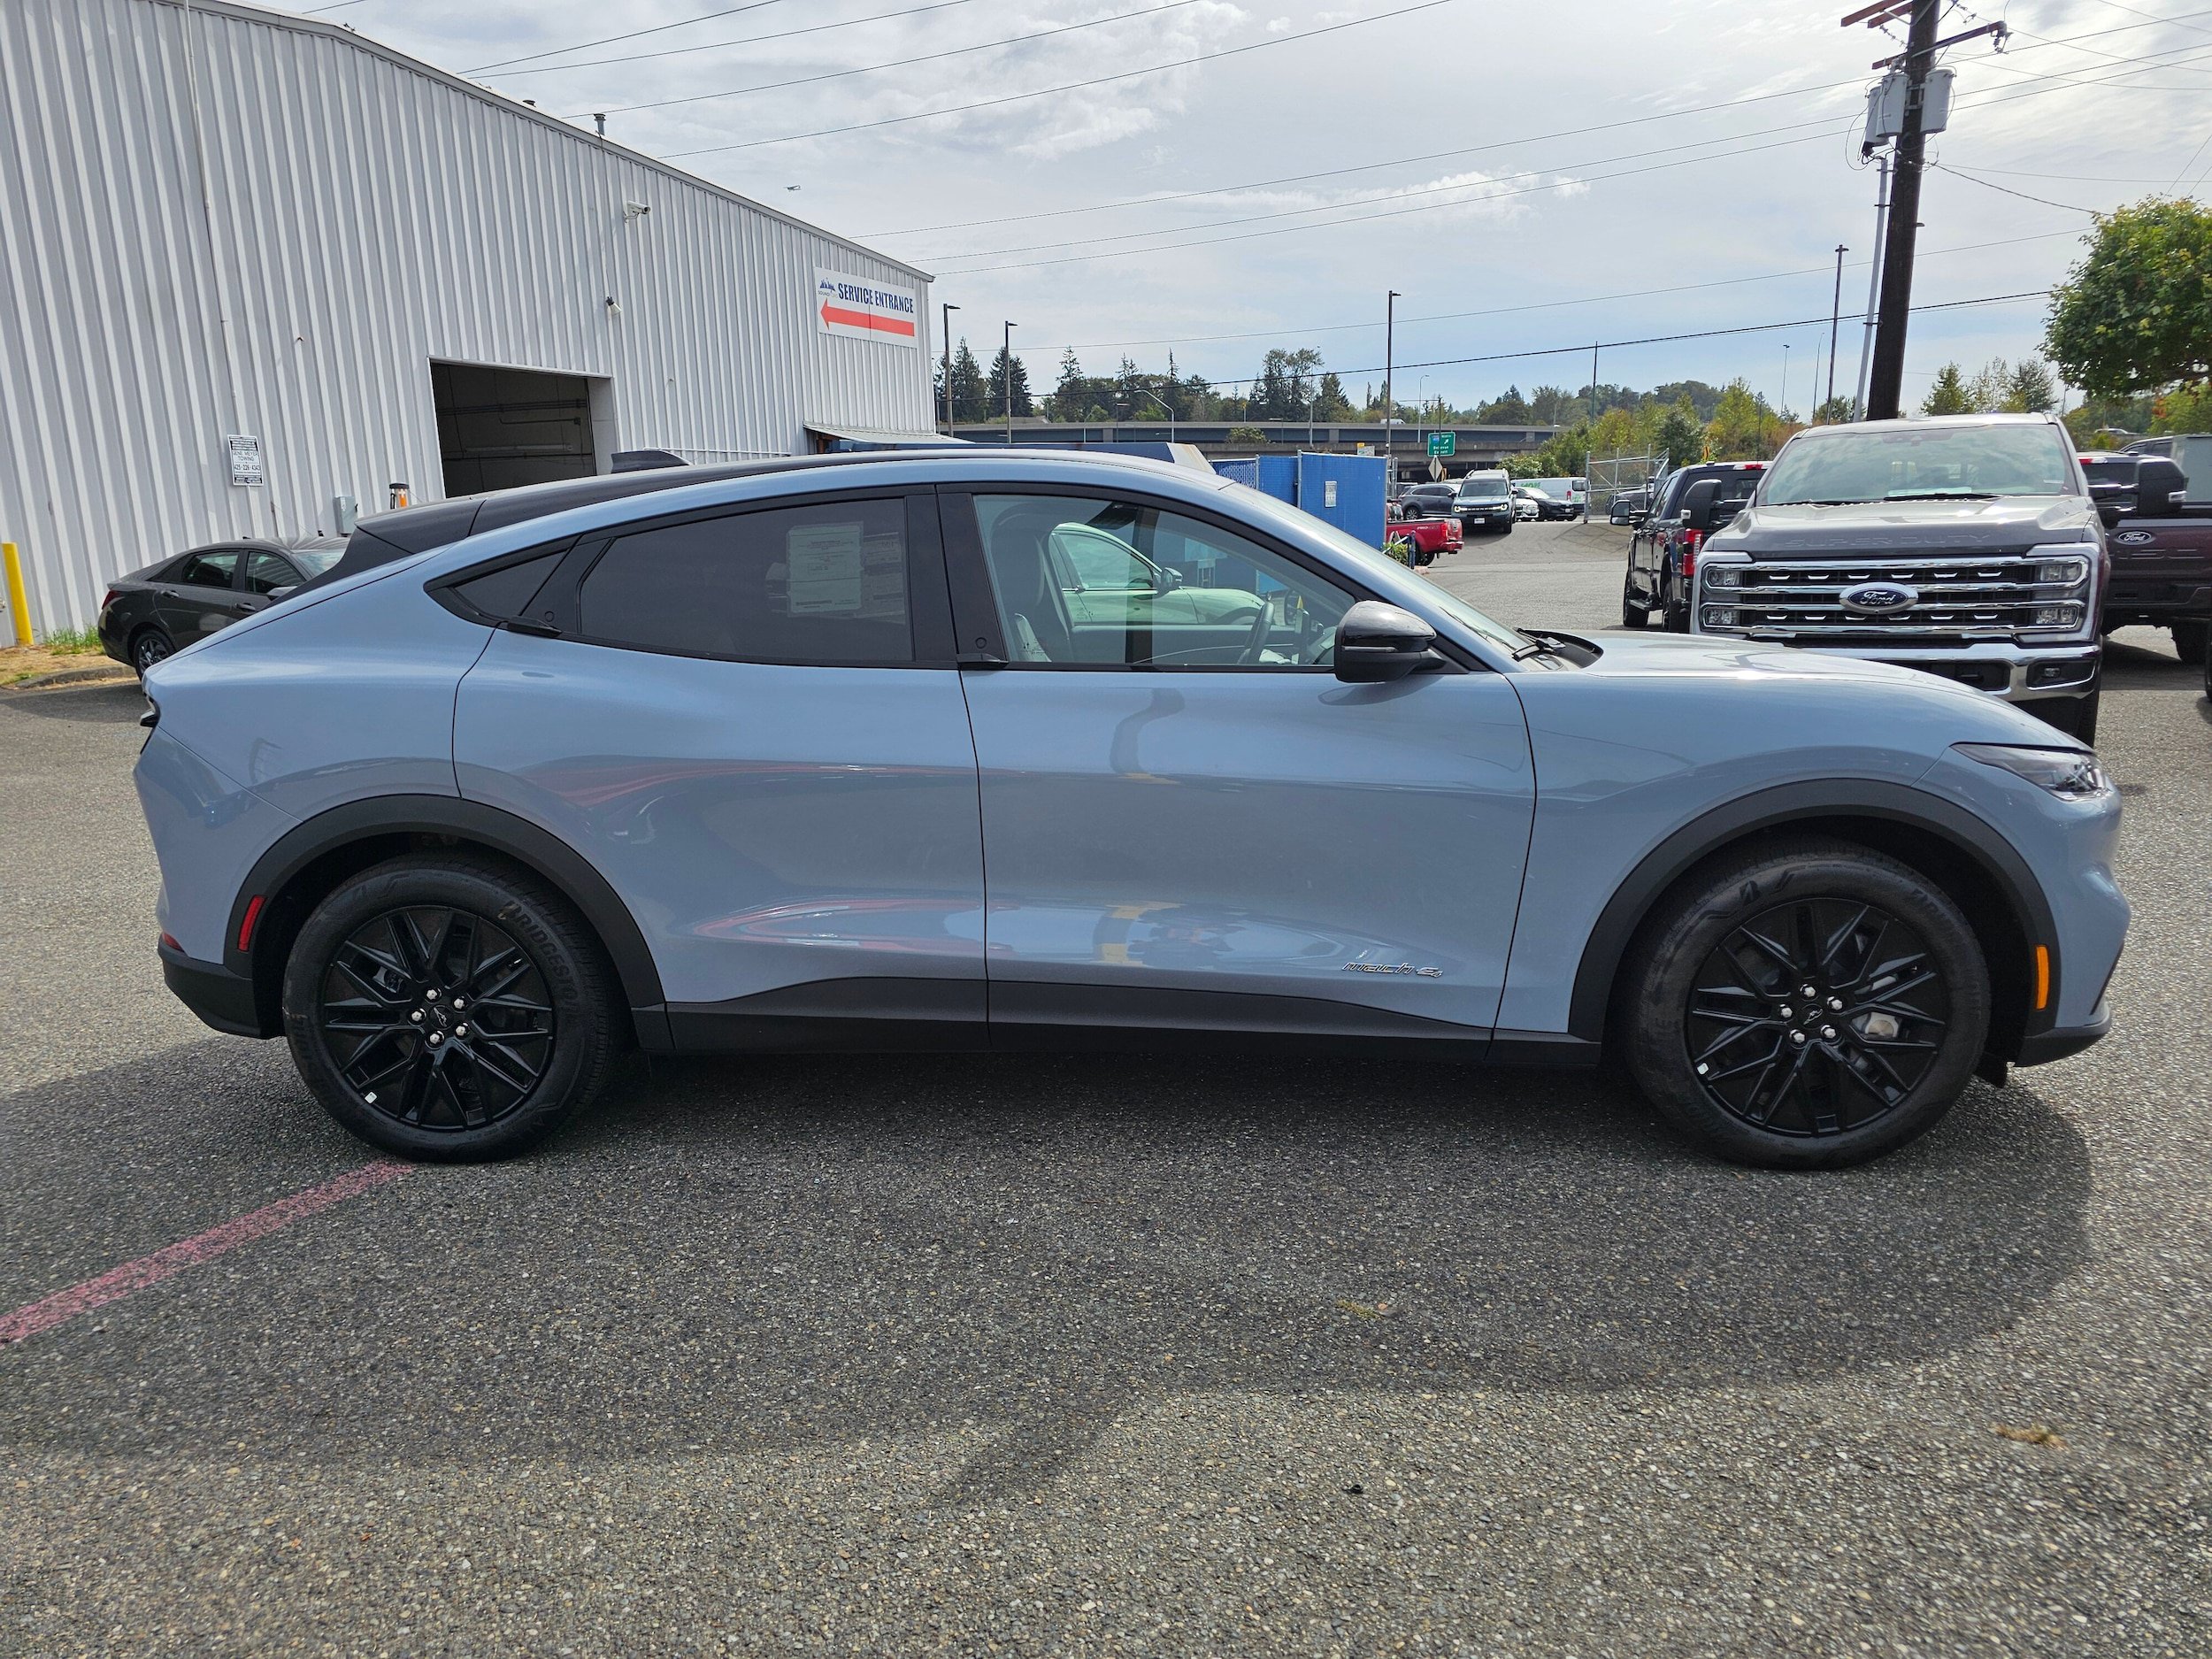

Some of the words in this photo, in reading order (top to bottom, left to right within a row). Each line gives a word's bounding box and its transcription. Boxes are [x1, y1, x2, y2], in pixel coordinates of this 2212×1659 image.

[838, 282, 874, 305] SERVICE
[875, 289, 914, 313] ENTRANCE
[1785, 536, 1893, 548] SUPER
[1900, 533, 1991, 545] DUTY
[2124, 532, 2145, 541] Ford
[1859, 590, 1896, 605] Ford
